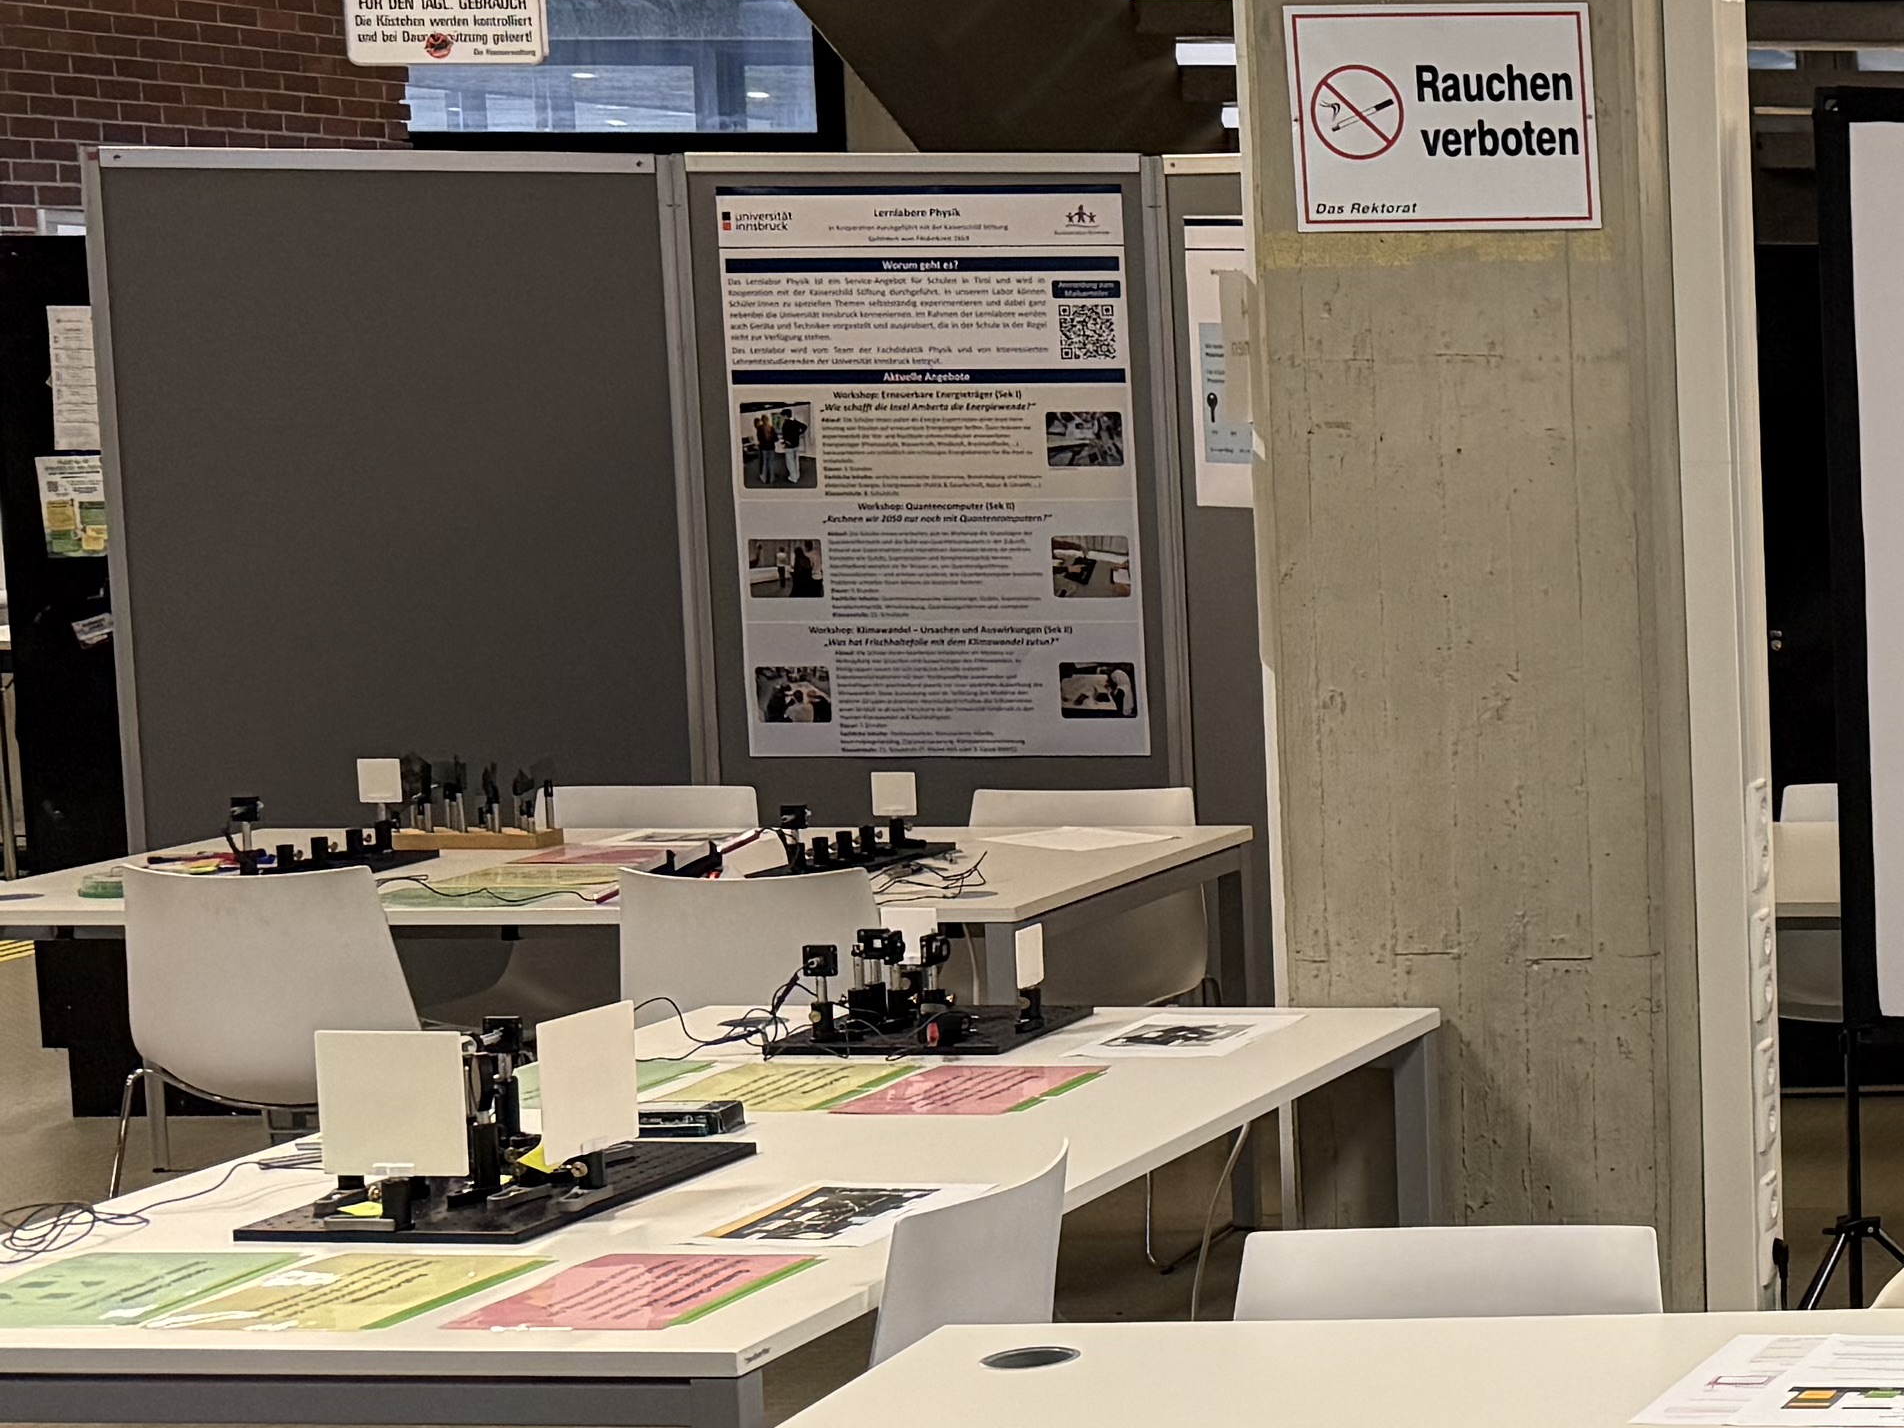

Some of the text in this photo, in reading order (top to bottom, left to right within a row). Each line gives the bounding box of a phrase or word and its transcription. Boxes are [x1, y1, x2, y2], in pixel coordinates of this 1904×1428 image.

[355, 15, 532, 26] Die Kästchen werden kontrolliert
[358, 32, 377, 43] und
[382, 31, 397, 43] bei
[1416, 64, 1572, 102] Rauchen
[1421, 120, 1579, 157] verboten
[1316, 201, 1418, 214] Das Rektorat
[735, 212, 792, 221] universität
[929, 208, 960, 218] Physik
[735, 222, 788, 231] innsbruck
[882, 260, 958, 270] Worum geht es?
[786, 278, 809, 286] Physik
[845, 278, 906, 286] Service-Angebot
[884, 372, 970, 383] Aktuelle Angebote
[833, 391, 878, 399] Workshop:
[881, 391, 933, 399] Erneuerbare
[936, 390, 993, 400] Energieträger
[858, 503, 903, 511] Workshop:
[906, 503, 983, 511] Quantencomputer
[809, 626, 854, 635] Workshop:
[857, 626, 911, 634] Klimawandel
[921, 626, 960, 634] Ursachen
[963, 626, 979, 634] und
[981, 626, 1042, 635] Auswirkungen
